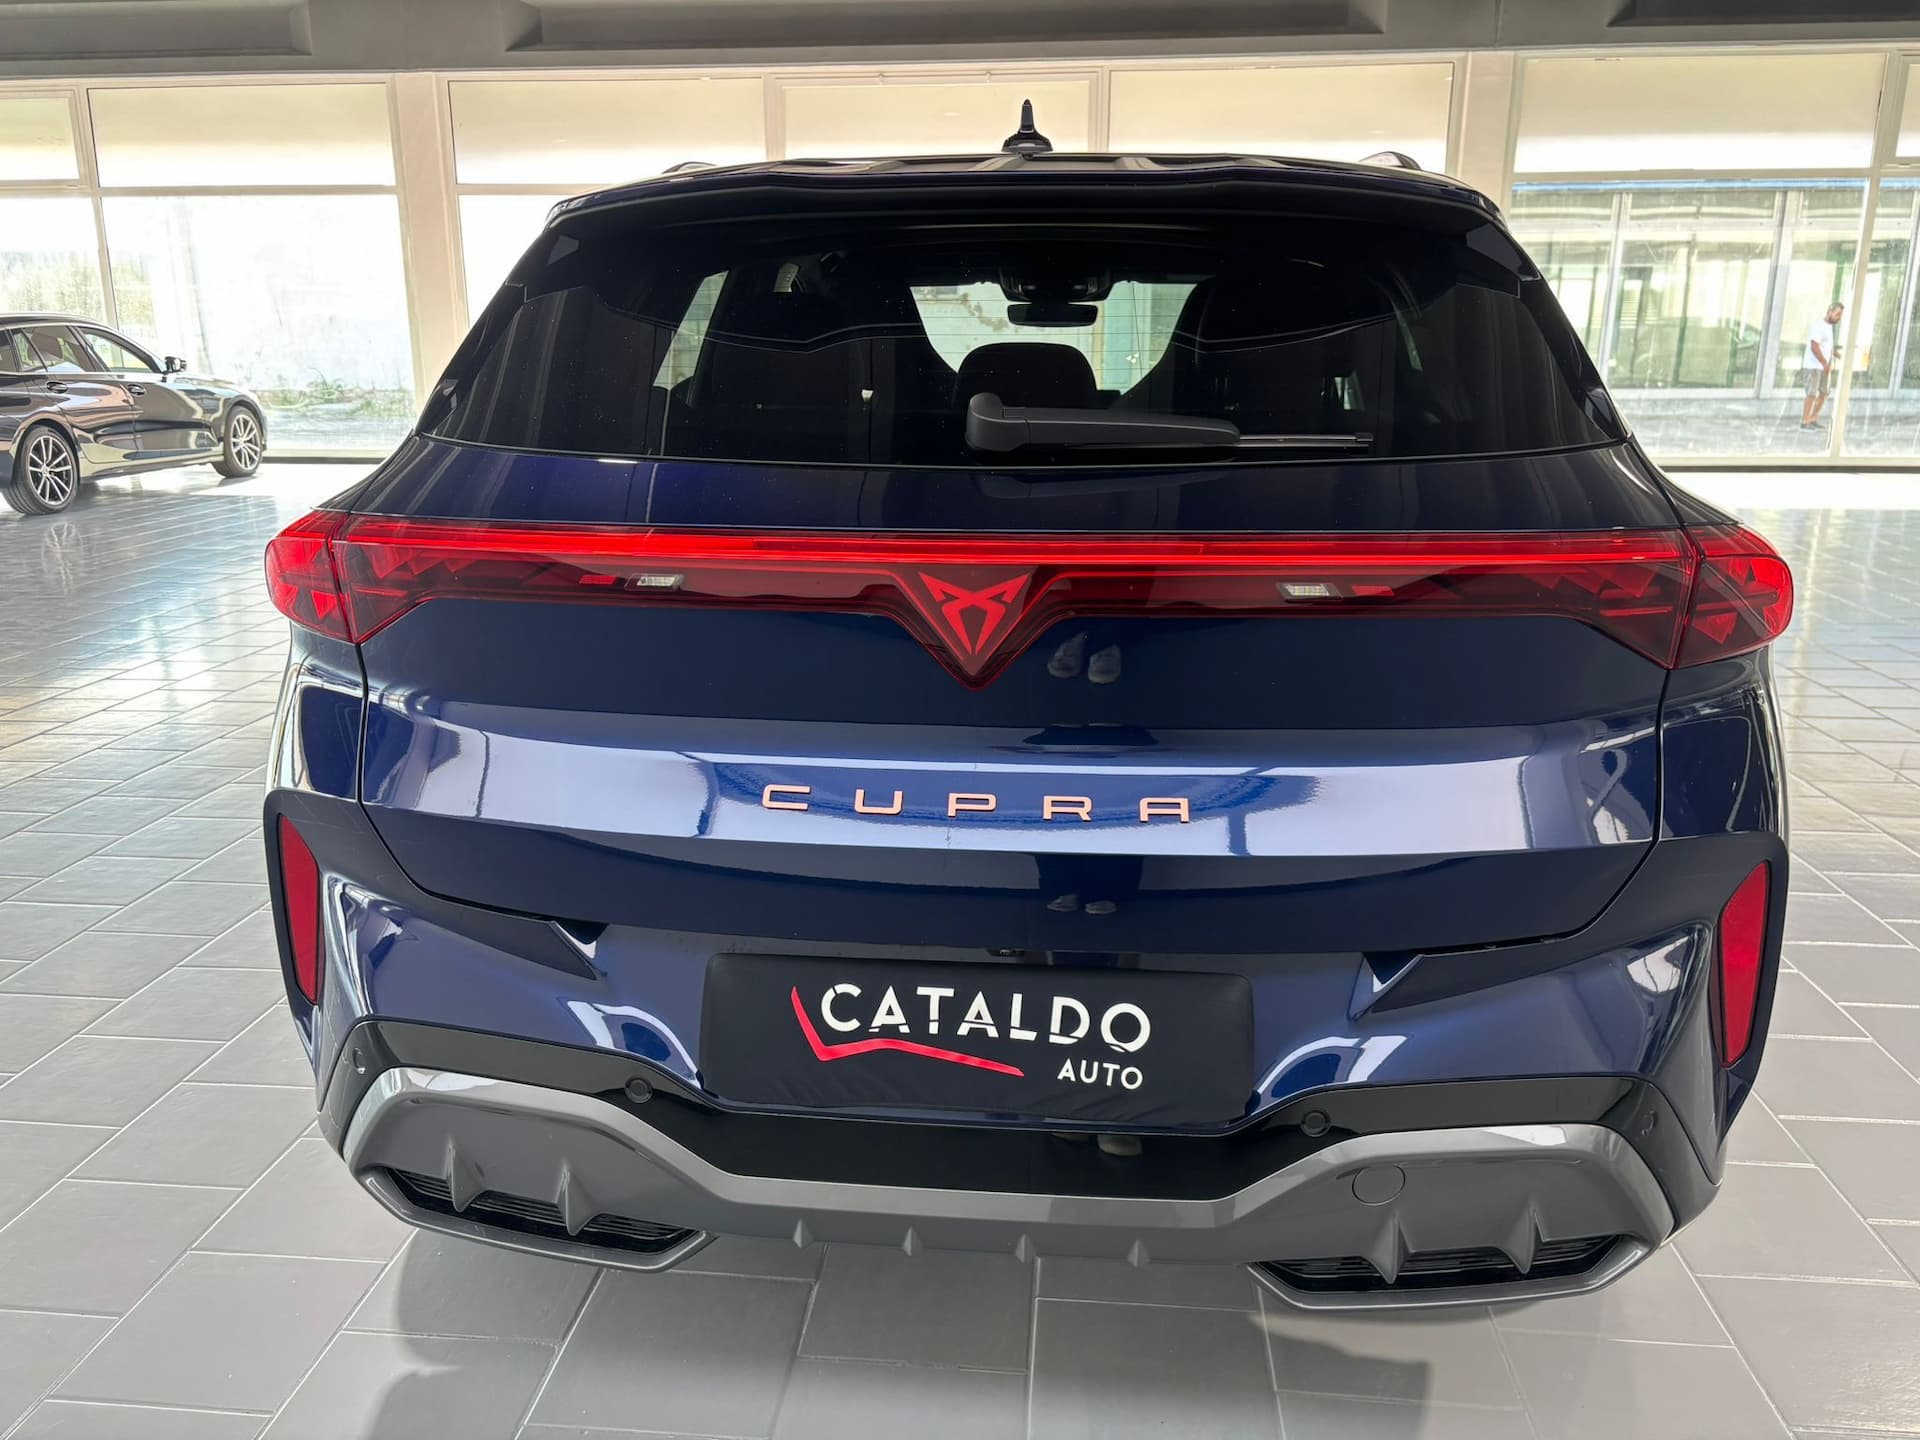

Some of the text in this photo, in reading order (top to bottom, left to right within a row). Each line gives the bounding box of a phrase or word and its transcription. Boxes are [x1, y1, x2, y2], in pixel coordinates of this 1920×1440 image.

[762, 784, 1190, 822] CUPRA
[821, 983, 1151, 1053] CATALDO
[1057, 1058, 1143, 1090] AUTO
